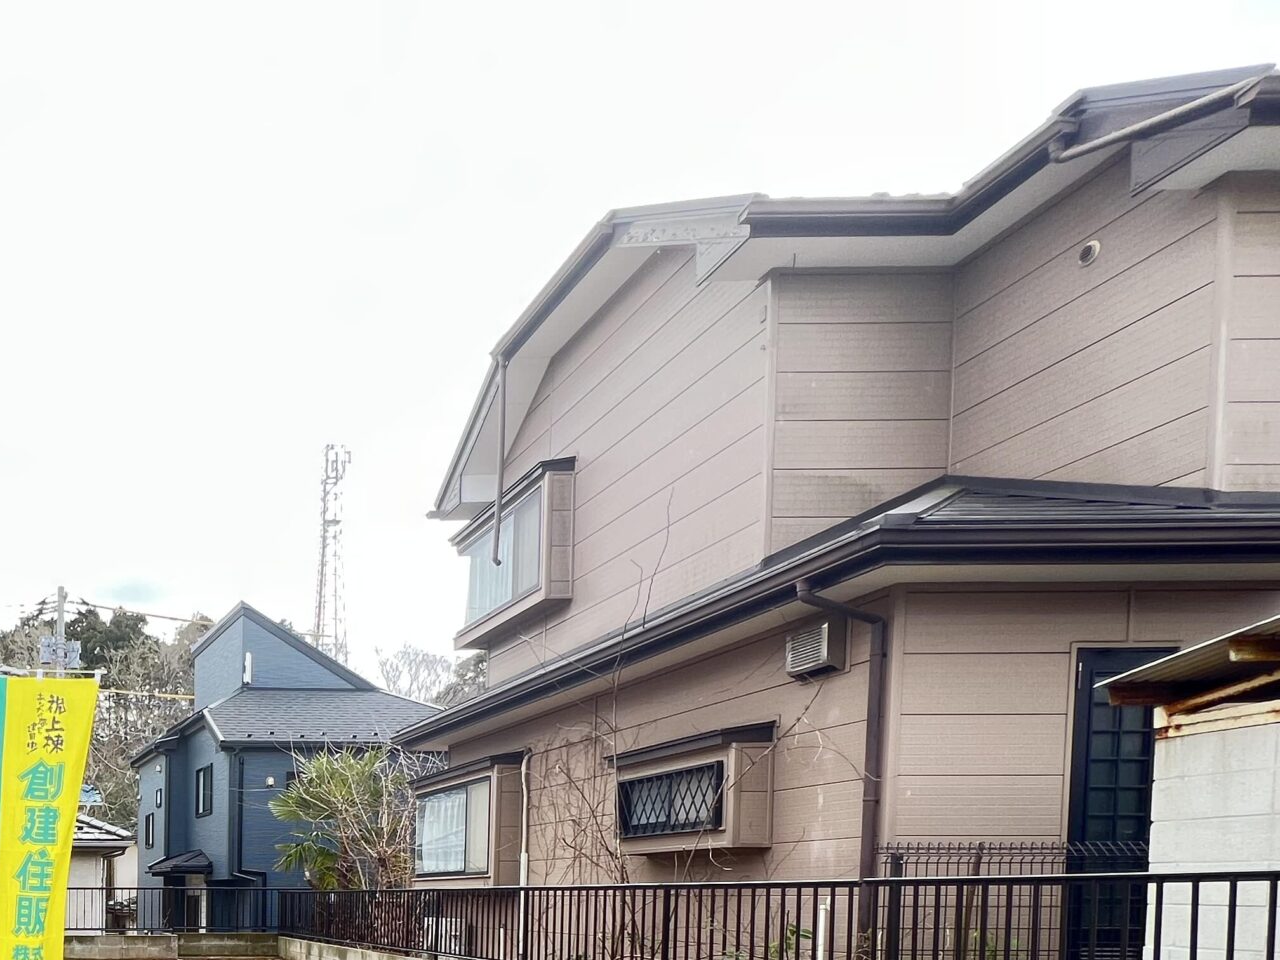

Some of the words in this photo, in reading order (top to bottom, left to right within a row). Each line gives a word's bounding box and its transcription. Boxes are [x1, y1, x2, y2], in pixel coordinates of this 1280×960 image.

[43, 694, 66, 754] 祝上棟
[12, 757, 65, 937] 創建住販
